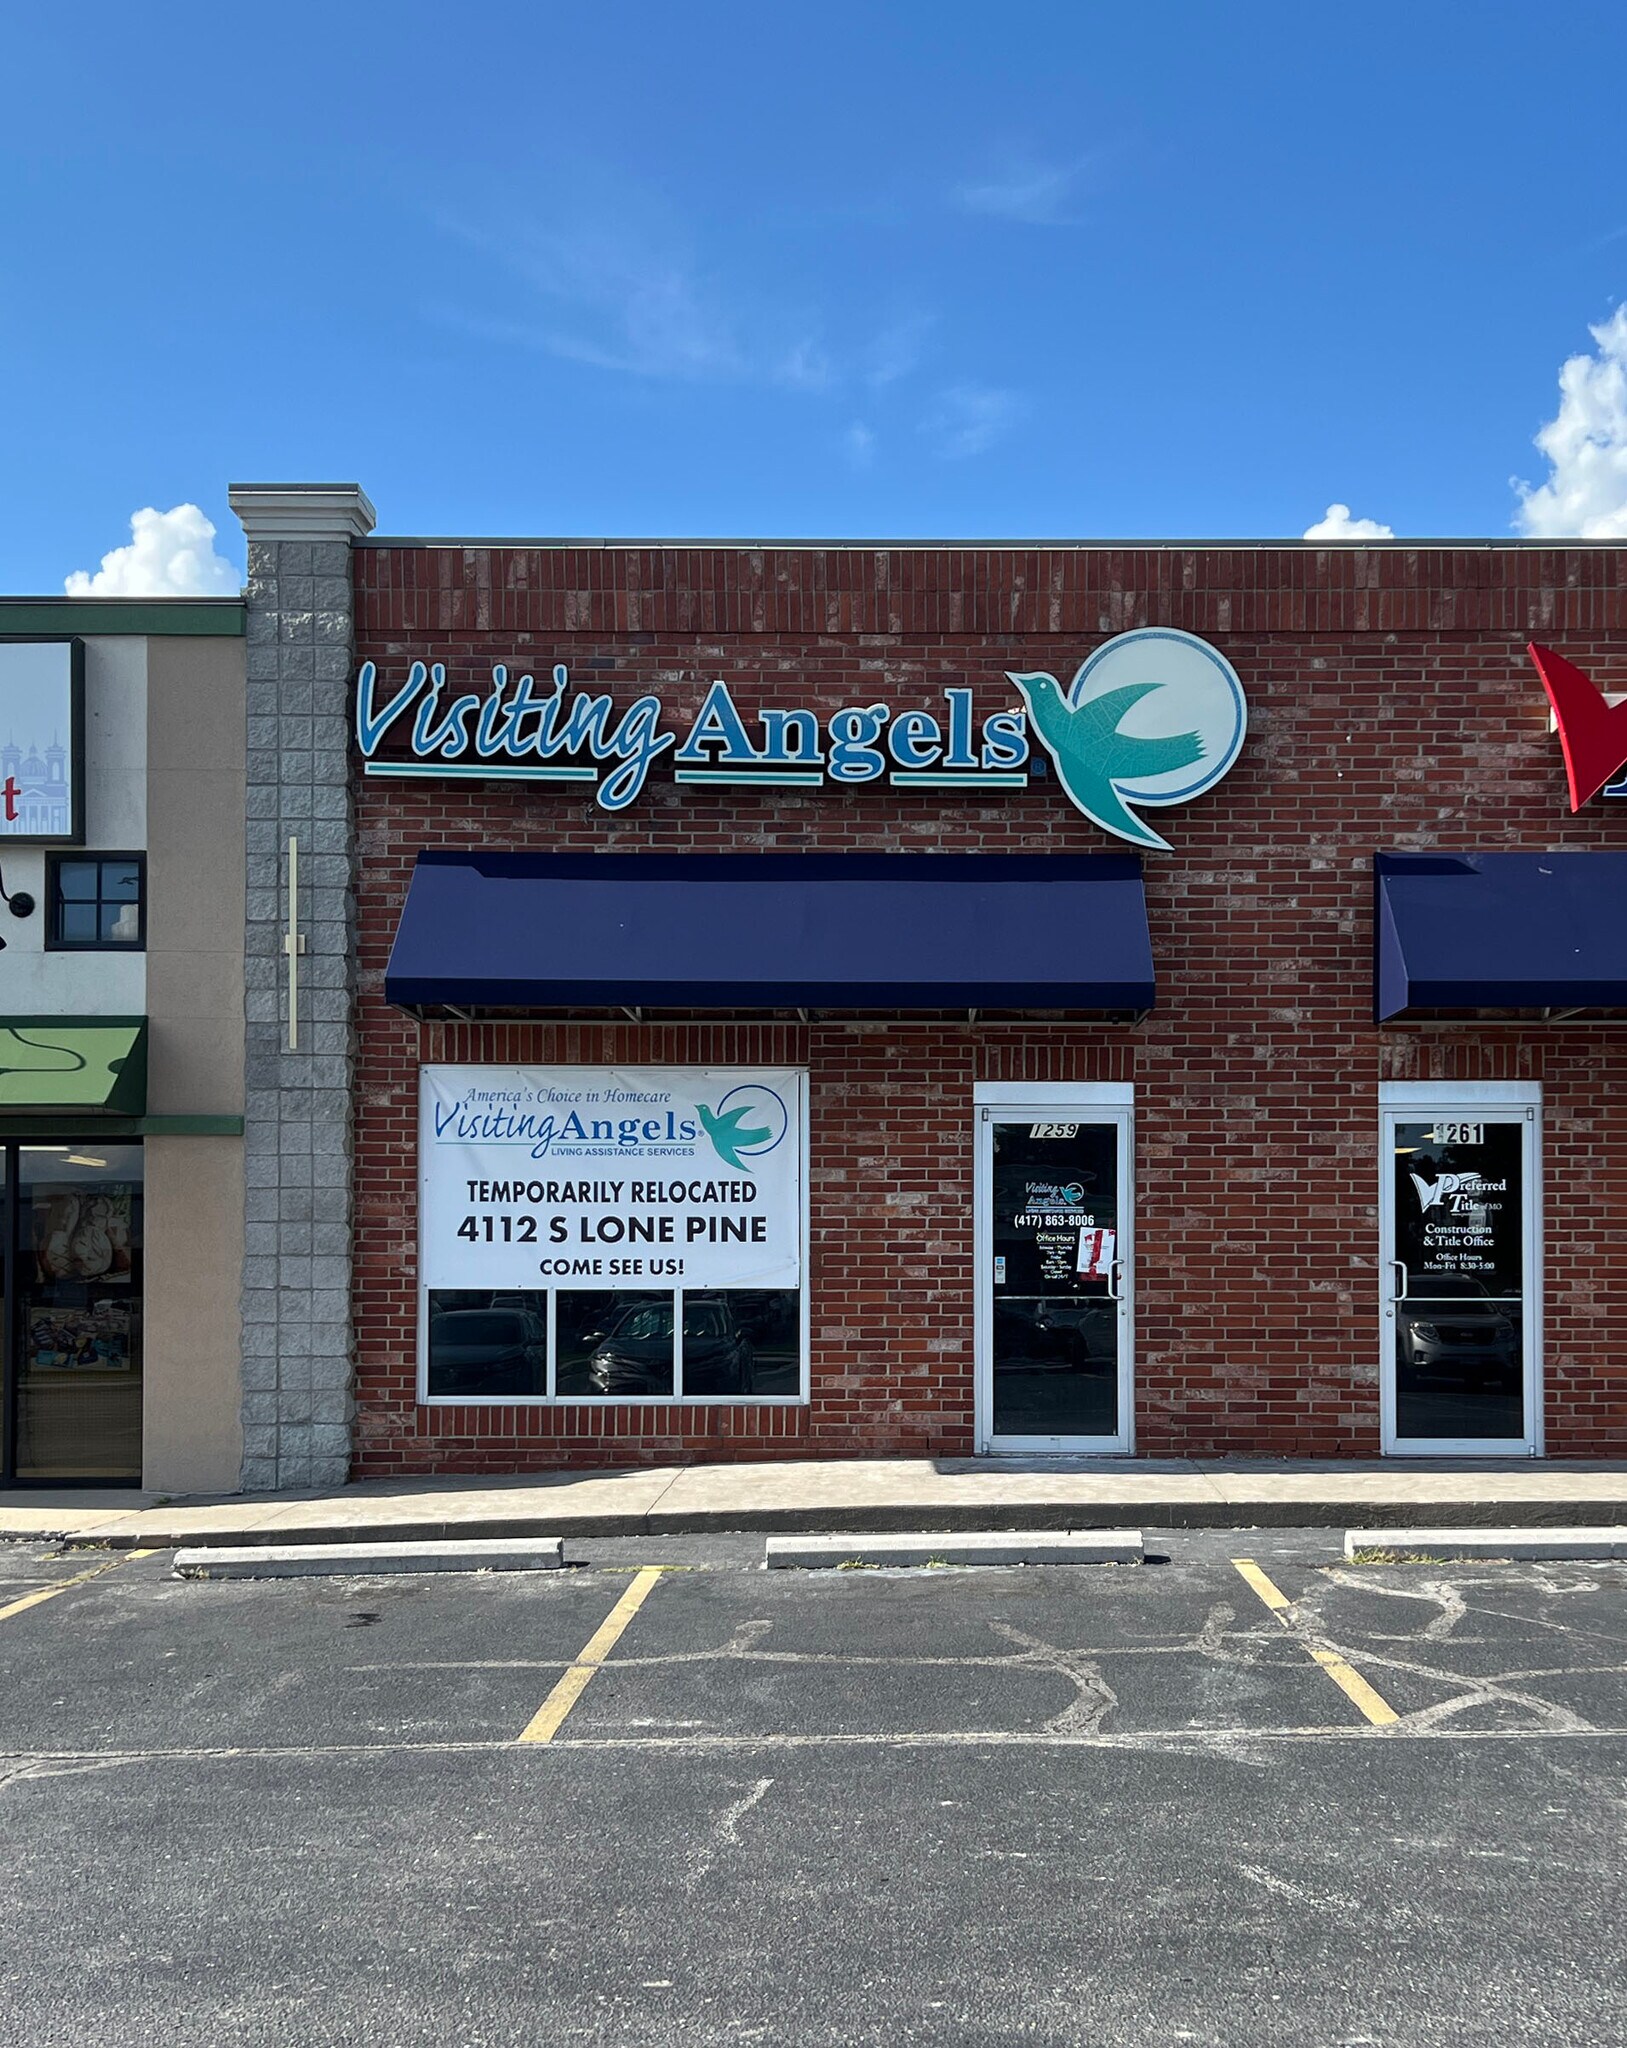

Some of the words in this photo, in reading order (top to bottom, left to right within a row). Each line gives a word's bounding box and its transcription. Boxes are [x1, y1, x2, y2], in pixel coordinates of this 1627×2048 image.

[356, 661, 676, 811] Visiting
[674, 680, 1029, 783] Angels
[463, 1087, 533, 1104] America's
[537, 1087, 582, 1104] Choice
[586, 1089, 599, 1103] in
[603, 1088, 671, 1104] Homecare
[435, 1102, 560, 1159] Visiting
[558, 1110, 696, 1147] Angels
[1034, 1123, 1077, 1137] 1259
[551, 1148, 583, 1156] LIVING
[585, 1148, 644, 1156] ASSISTANCE
[647, 1148, 695, 1156] SERVICES
[466, 1180, 624, 1203] TEMPORARILY
[631, 1180, 757, 1203] RELOCATED
[1430, 1173, 1507, 1205] Preferred
[1449, 1194, 1479, 1212] Title
[1014, 1214, 1042, 1228] (417)
[1045, 1215, 1095, 1226] 863-8006
[1425, 1223, 1492, 1234] Construction
[457, 1215, 538, 1242] 4112
[549, 1215, 568, 1243] S
[580, 1215, 675, 1243] LONE
[686, 1216, 767, 1242] PINE
[1036, 1234, 1056, 1242] Office
[1056, 1234, 1075, 1242] Hours
[1423, 1236, 1435, 1246] &
[1435, 1235, 1461, 1246] Title
[1463, 1235, 1495, 1246] Office
[1436, 1252, 1458, 1261] Office
[1459, 1252, 1482, 1261] Hours
[539, 1258, 603, 1275] COME
[609, 1258, 643, 1275] SEE
[650, 1258, 684, 1275] US!
[1423, 1261, 1456, 1270] Mon-Fri
[1460, 1262, 1495, 1270] 8:30-5:00
